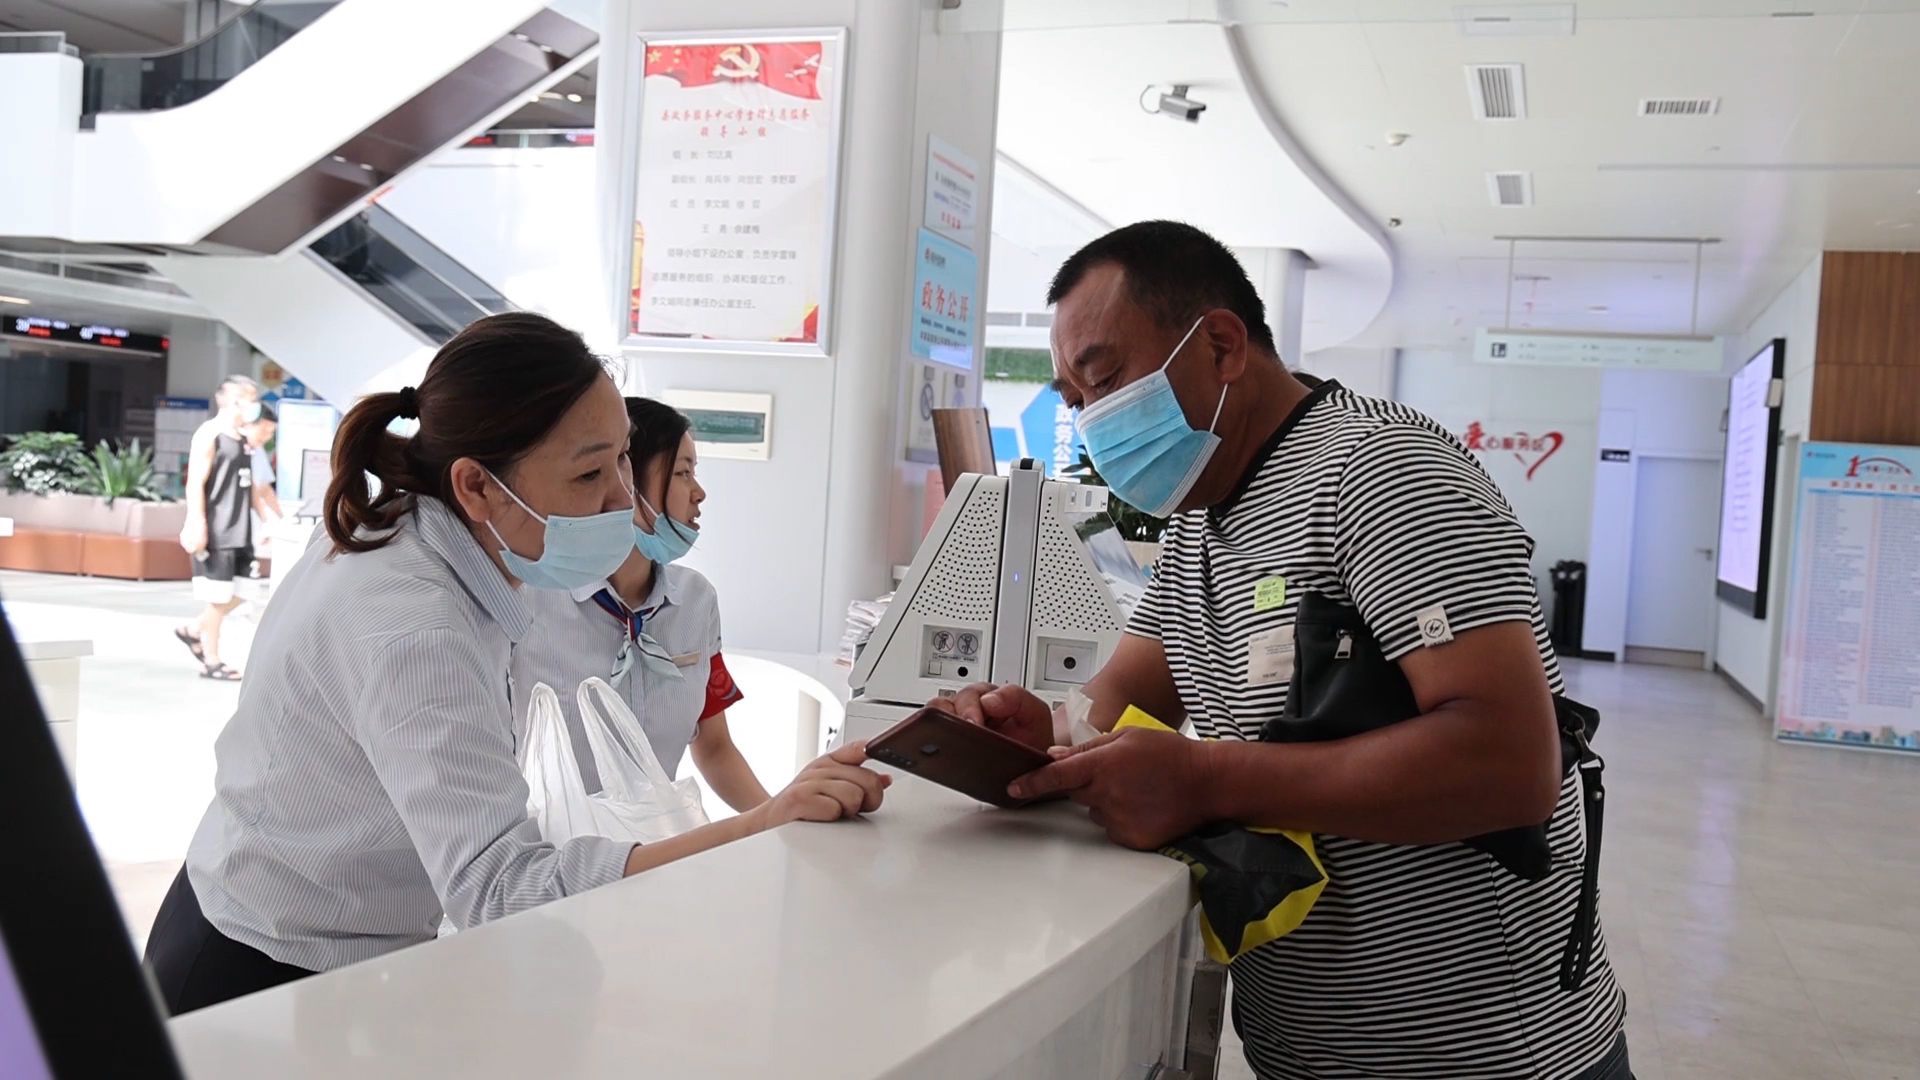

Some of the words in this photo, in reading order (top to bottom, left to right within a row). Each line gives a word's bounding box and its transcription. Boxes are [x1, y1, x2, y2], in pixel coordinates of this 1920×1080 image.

[921, 280, 969, 323] 政务公开
[1464, 420, 1545, 452] 爱心服务区
